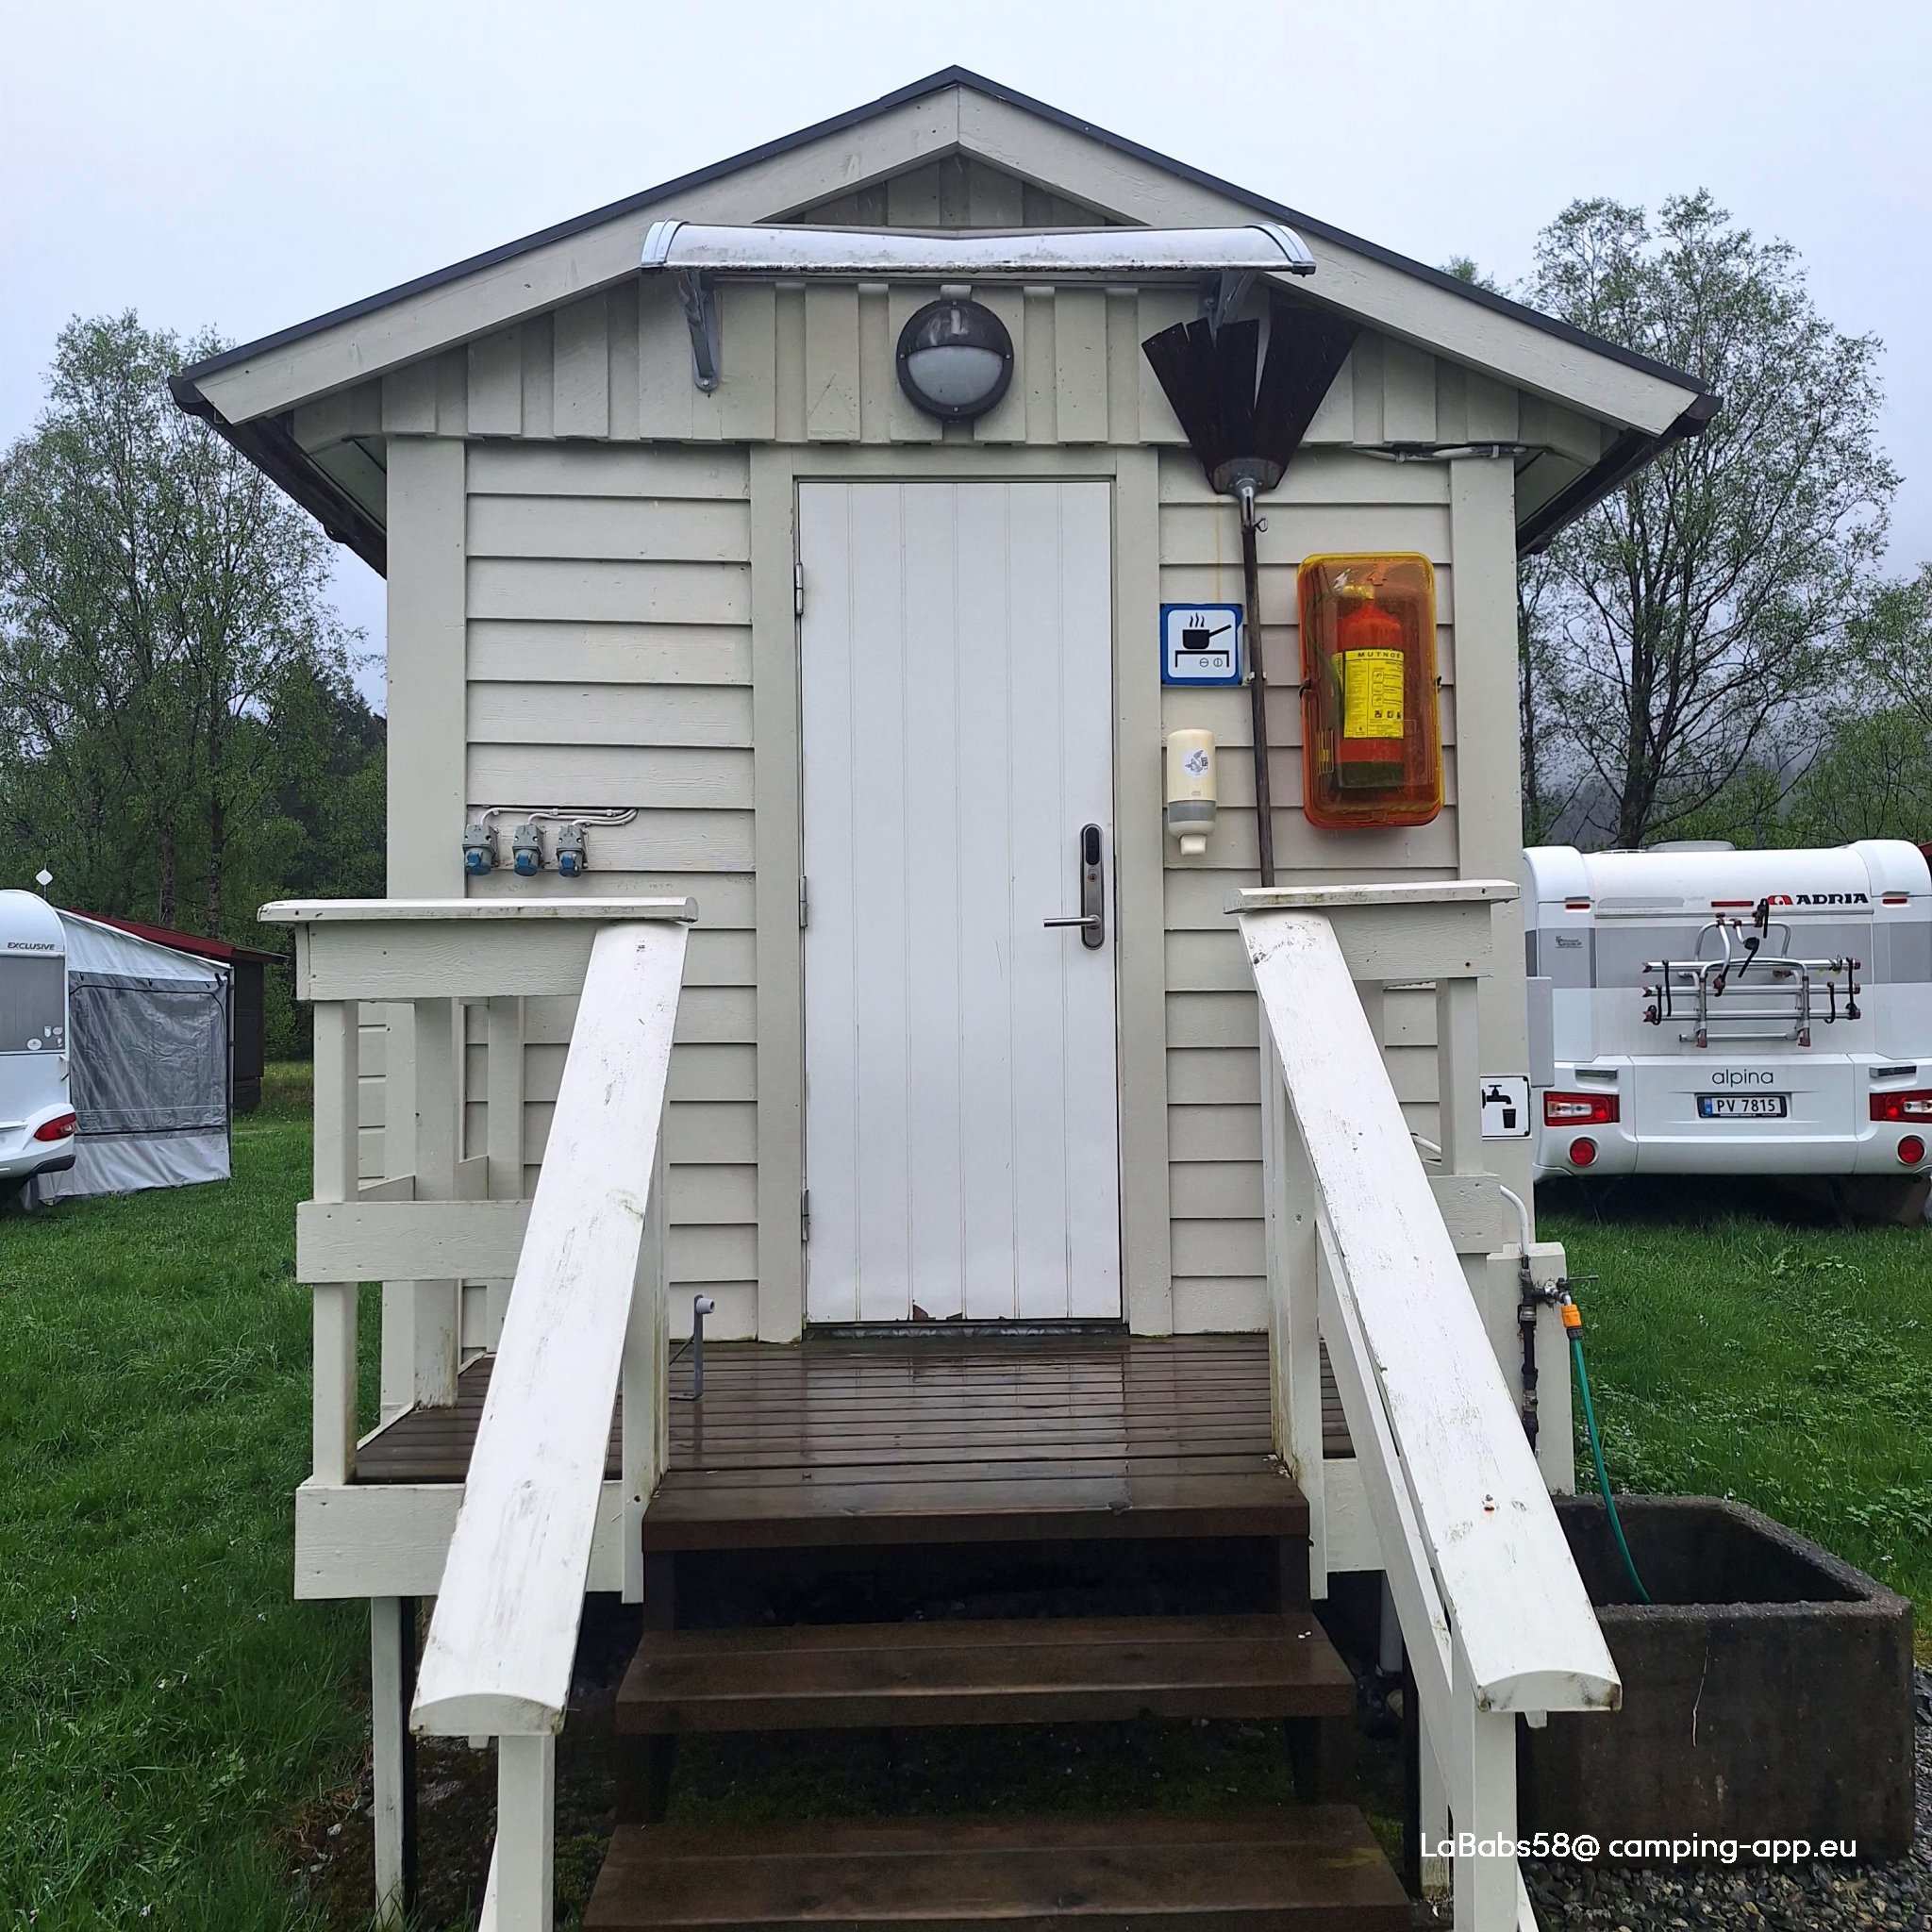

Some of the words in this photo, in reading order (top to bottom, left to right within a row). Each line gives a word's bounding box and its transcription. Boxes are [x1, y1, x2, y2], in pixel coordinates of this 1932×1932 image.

[1796, 893, 1869, 905] ADRIA
[8, 942, 55, 951] EXCLUSIVE
[1712, 1069, 1774, 1088] alpina
[1717, 1099, 1735, 1112] PV
[1741, 1099, 1775, 1112] 7815
